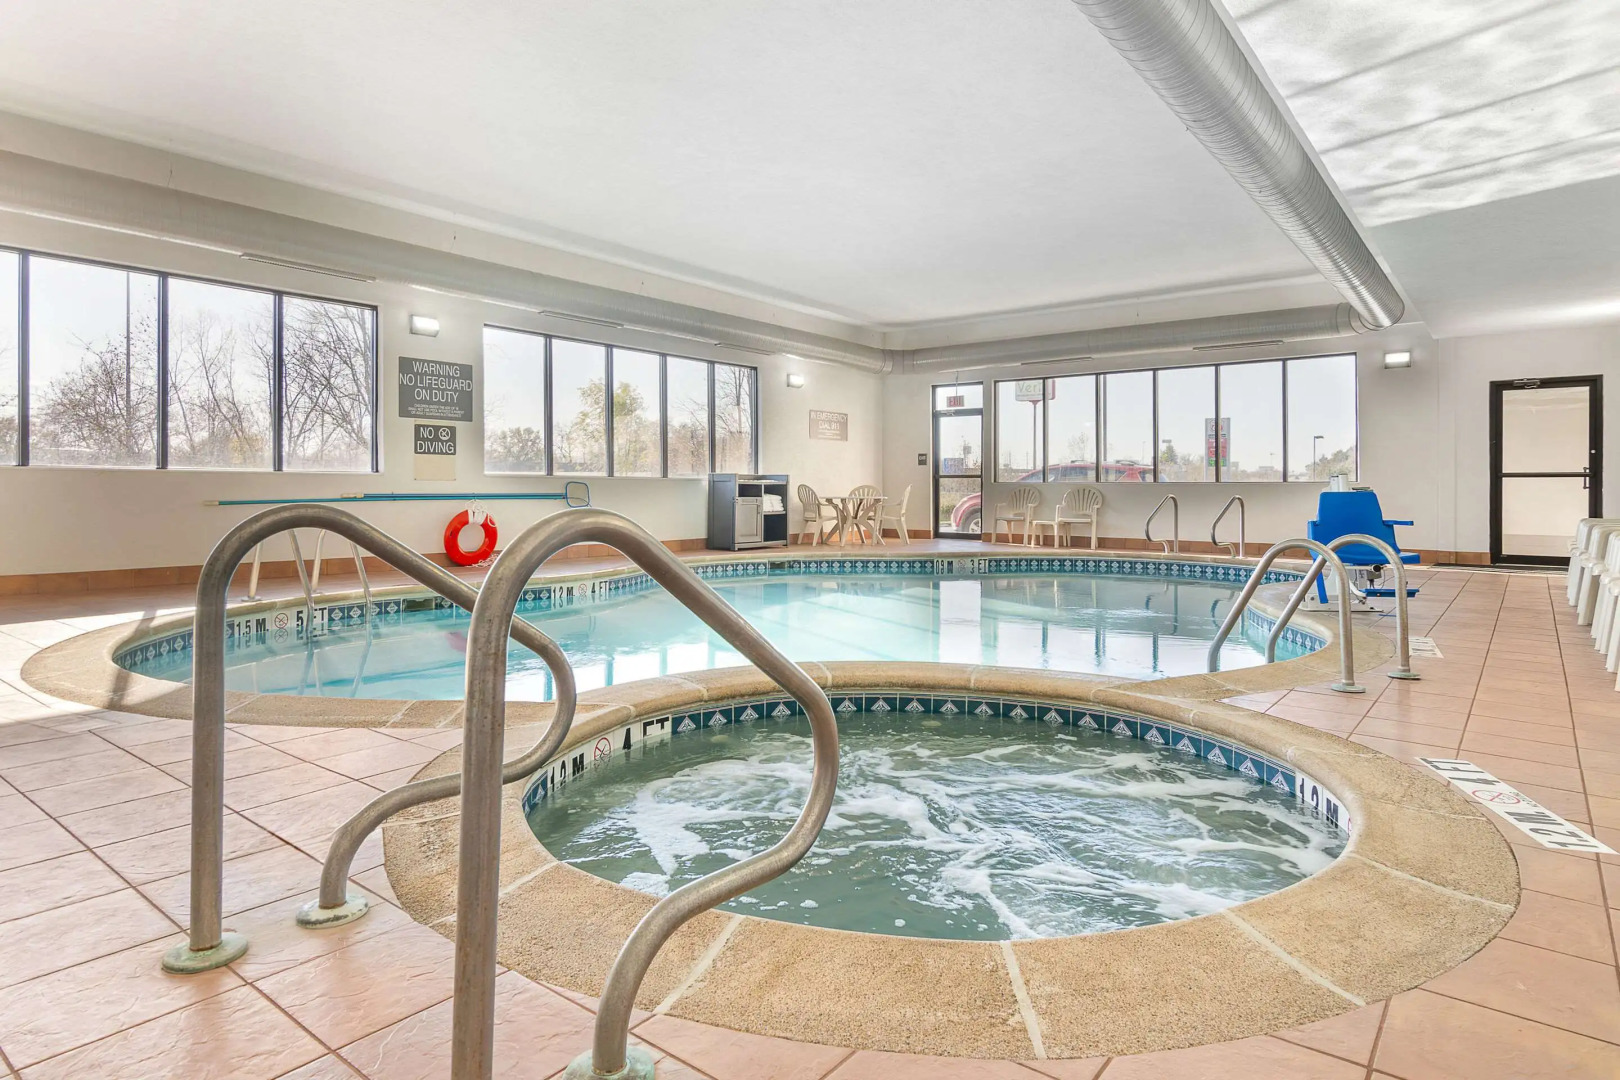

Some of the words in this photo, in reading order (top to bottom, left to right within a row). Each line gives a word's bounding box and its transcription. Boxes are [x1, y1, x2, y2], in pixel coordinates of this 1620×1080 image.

[412, 361, 460, 377] WARNING
[399, 373, 415, 386] NO
[417, 375, 473, 391] LIFEGUARD
[414, 388, 430, 401] ON
[432, 390, 459, 403] DUTY
[420, 426, 435, 439] NO
[417, 441, 454, 454] DIVING
[591, 582, 596, 594] 4
[296, 610, 304, 627] 5
[1420, 757, 1485, 774] FT
